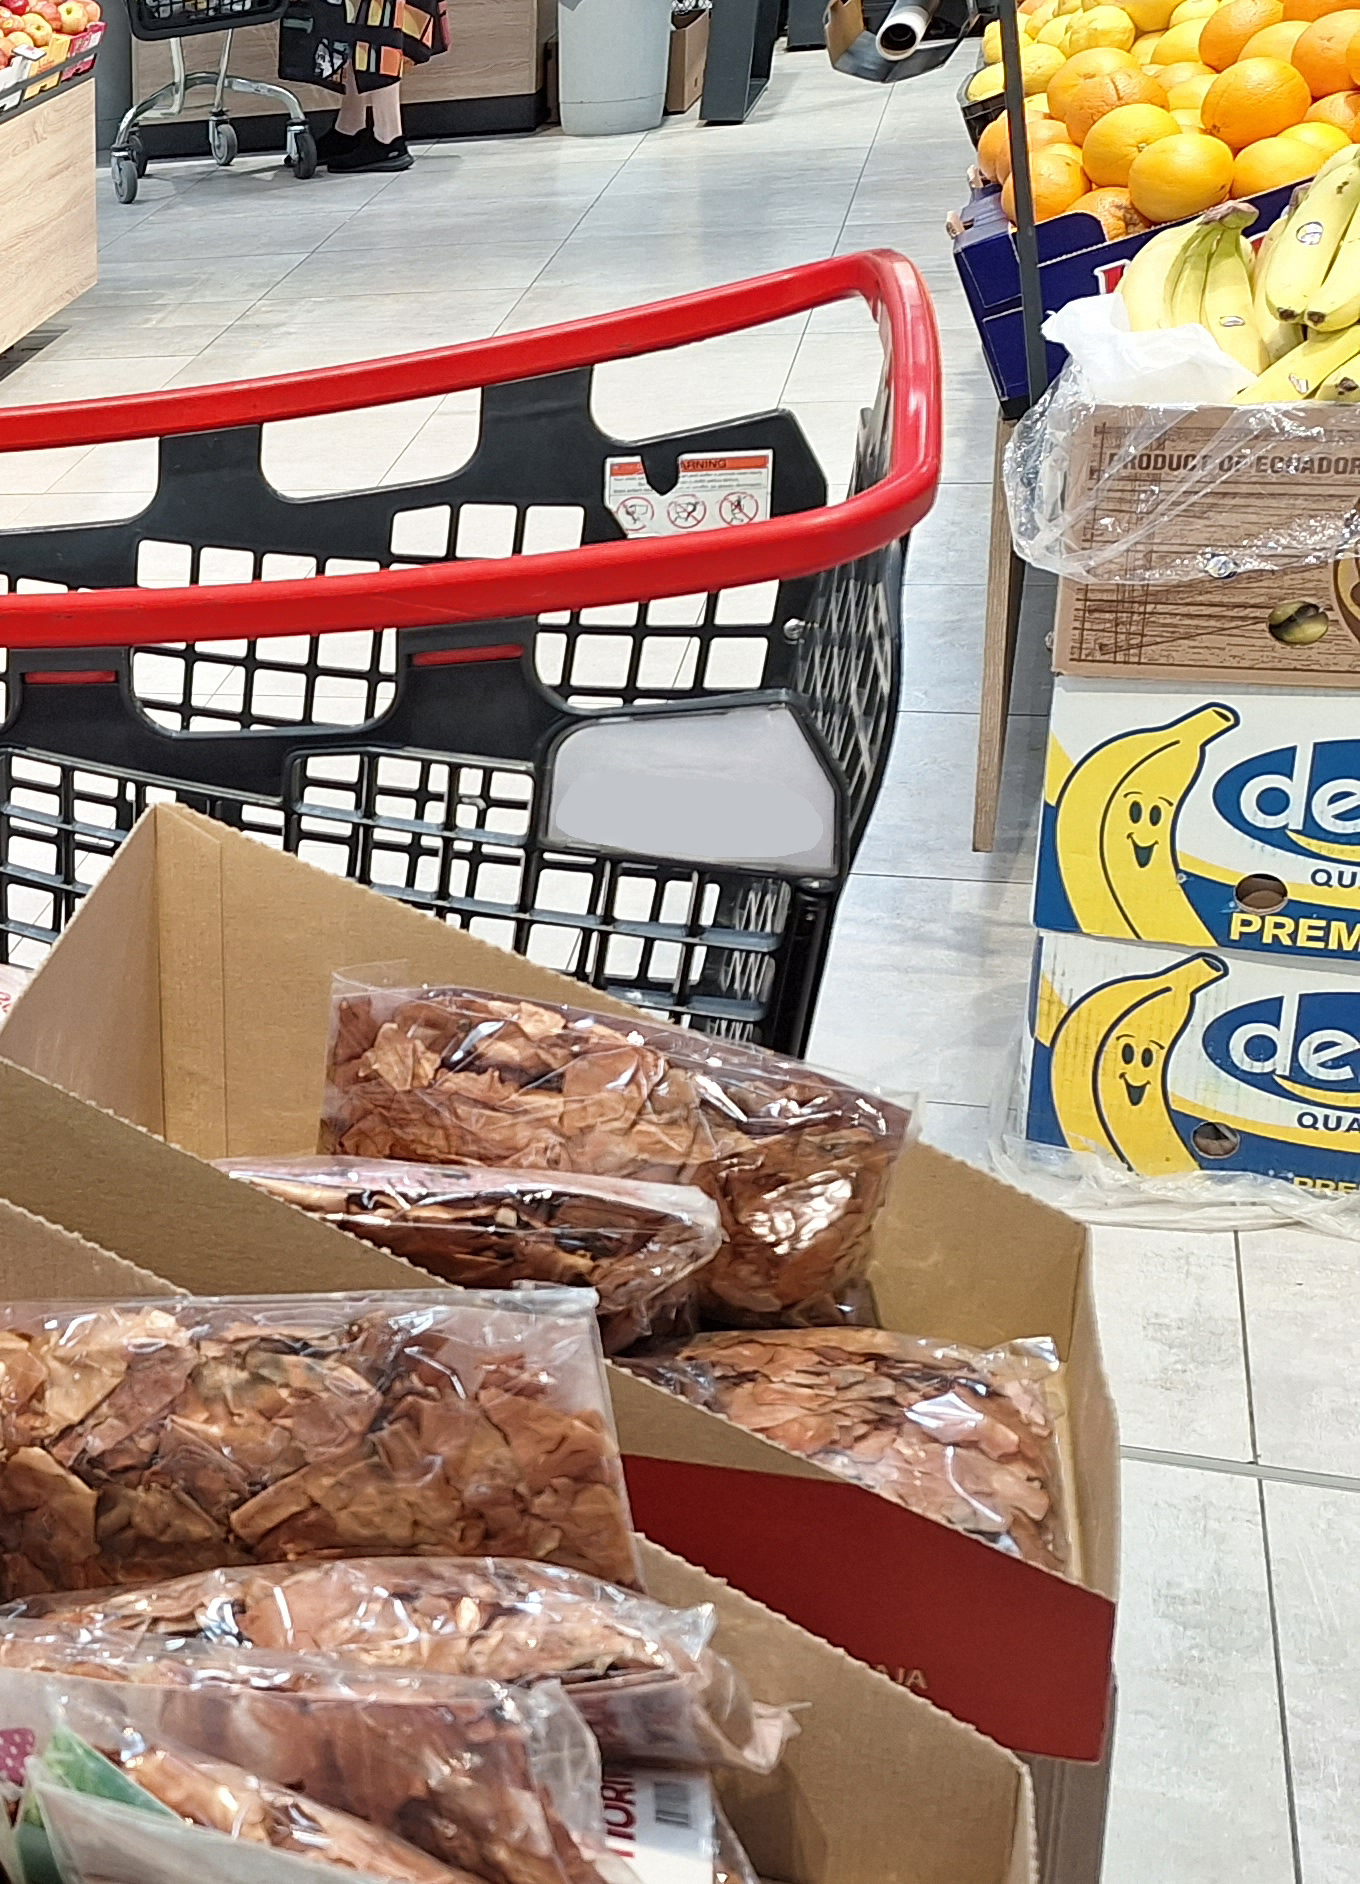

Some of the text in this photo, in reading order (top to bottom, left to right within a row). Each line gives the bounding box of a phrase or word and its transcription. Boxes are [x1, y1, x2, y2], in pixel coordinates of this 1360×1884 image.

[680, 459, 727, 471] ARNING
[1108, 453, 1213, 472] PRODUCT
[1310, 868, 1360, 889] QU
